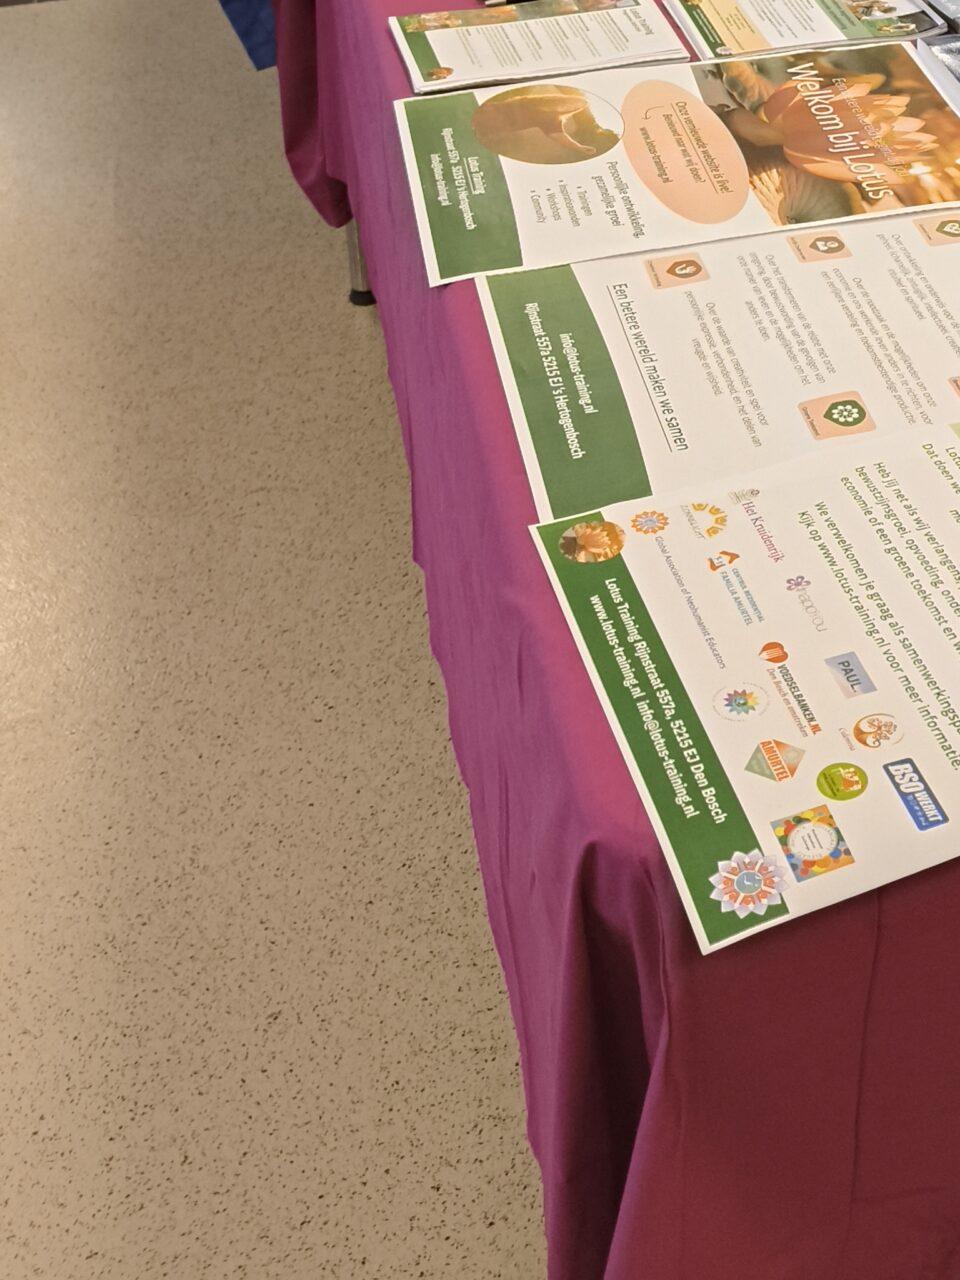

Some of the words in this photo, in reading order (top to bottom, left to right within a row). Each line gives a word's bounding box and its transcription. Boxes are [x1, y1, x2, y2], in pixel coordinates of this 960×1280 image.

[787, 62, 843, 130] Welkom
[639, 126, 673, 183] www.lotus-training.nl
[827, 130, 868, 152] bij
[464, 155, 479, 172] Lotus
[842, 152, 894, 199] Lotus
[468, 170, 486, 195] Training
[590, 174, 616, 209] gezamelijke
[604, 208, 625, 227] groei
[606, 160, 629, 195] Persoonlijke
[620, 195, 645, 239] ontwikkeling,
[611, 282, 628, 300] Een
[524, 301, 546, 336] Rijnstraat
[619, 299, 640, 330] betere
[535, 335, 552, 356] 557a
[631, 330, 658, 363] wereld
[541, 355, 560, 376] 5215
[559, 332, 597, 413] info@lotus-training.nl
[644, 364, 667, 397] maken
[547, 376, 564, 387] EJ
[658, 397, 674, 415] we
[554, 394, 585, 459] Hertogenbosch
[664, 416, 688, 451] samen
[872, 461, 891, 479] Heb
[921, 442, 939, 459] Dat
[933, 459, 954, 480] doen
[840, 476, 873, 516] economie
[880, 477, 900, 488] jij
[891, 487, 909, 503] net
[813, 500, 829, 516] We
[867, 516, 884, 527] of
[902, 503, 918, 517] als
[912, 515, 931, 531] wij
[741, 500, 757, 516] Het
[750, 515, 785, 562] Kruidenrijk
[854, 465, 911, 538] bewustzijnsgroei,
[904, 538, 944, 589] opvoeding,
[875, 527, 892, 546] een
[824, 516, 867, 580] verwelkomen
[883, 545, 914, 578] groene
[604, 577, 623, 603] Lotus
[857, 579, 875, 591] je
[732, 595, 753, 626] AMURTEL
[797, 510, 816, 529] Kijk
[808, 528, 822, 542] op
[817, 542, 890, 647] www.lotus-training.nl
[882, 648, 904, 672] voor
[897, 674, 923, 703] meer
[865, 591, 894, 621] graag
[910, 578, 948, 626] toekomst
[616, 602, 642, 642] Training
[887, 620, 904, 636] als
[942, 626, 957, 641] en
[633, 640, 664, 689] Rijnstraat
[590, 594, 644, 698] www.lotus-training.nl
[637, 700, 698, 817] info@lotus-training.nl
[655, 688, 675, 720] 557a,
[777, 663, 821, 734] VOEDSELBANKEN.NL
[669, 719, 693, 748] 5215
[682, 747, 700, 763] EJ
[758, 739, 792, 781] AMURTEL
[689, 762, 708, 787] Den
[888, 763, 924, 793] BSO
[700, 786, 727, 823] Bosch
[914, 790, 942, 821] WERKT
